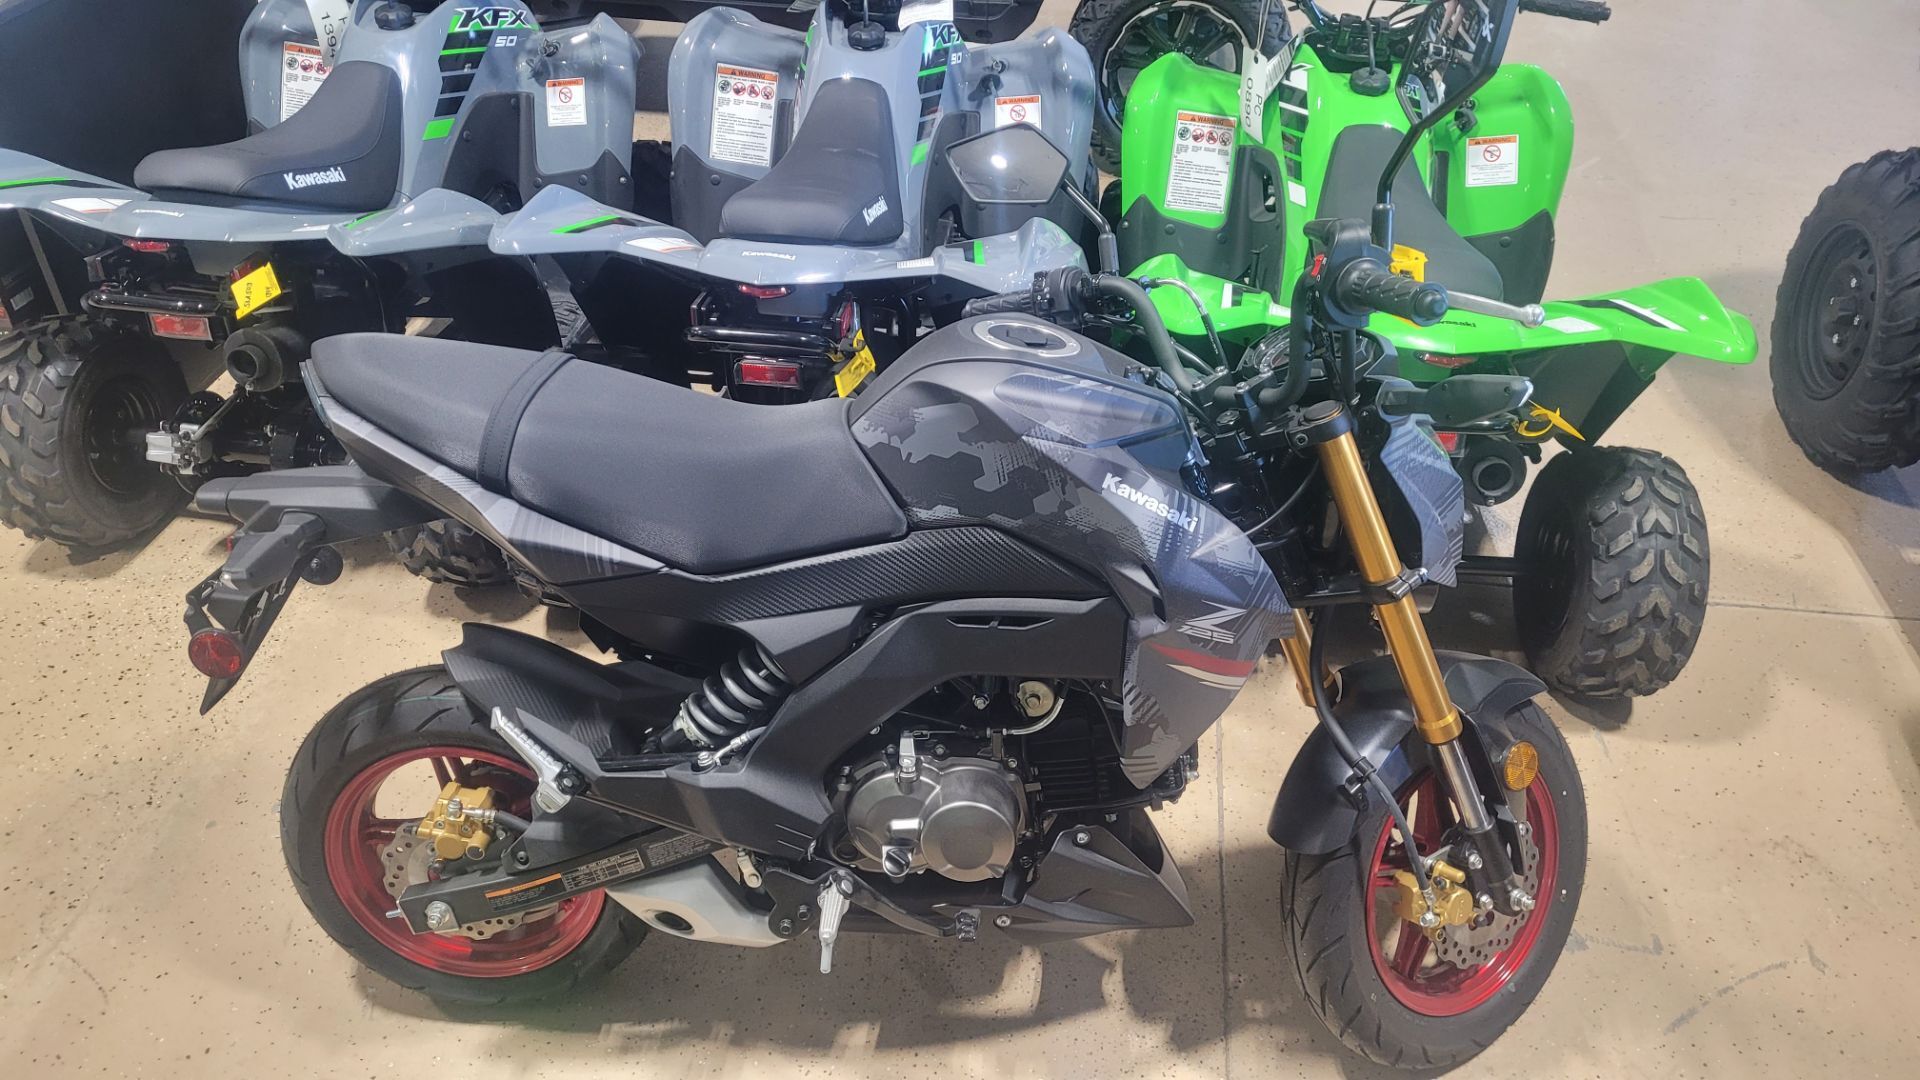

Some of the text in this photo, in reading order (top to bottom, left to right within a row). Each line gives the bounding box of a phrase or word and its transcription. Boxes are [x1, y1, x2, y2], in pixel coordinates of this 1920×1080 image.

[454, 7, 532, 31] KFX
[321, 11, 338, 58] 1394
[495, 35, 518, 47] 50
[950, 52, 963, 65] 90
[738, 69, 766, 79] WARNING
[1245, 77, 1254, 128] 0890
[1254, 93, 1263, 117] PC
[1196, 115, 1224, 125] WARNING
[283, 166, 347, 191] Kawasaki
[862, 195, 889, 227] Kawasaki
[1101, 472, 1199, 534] Kawasaki
